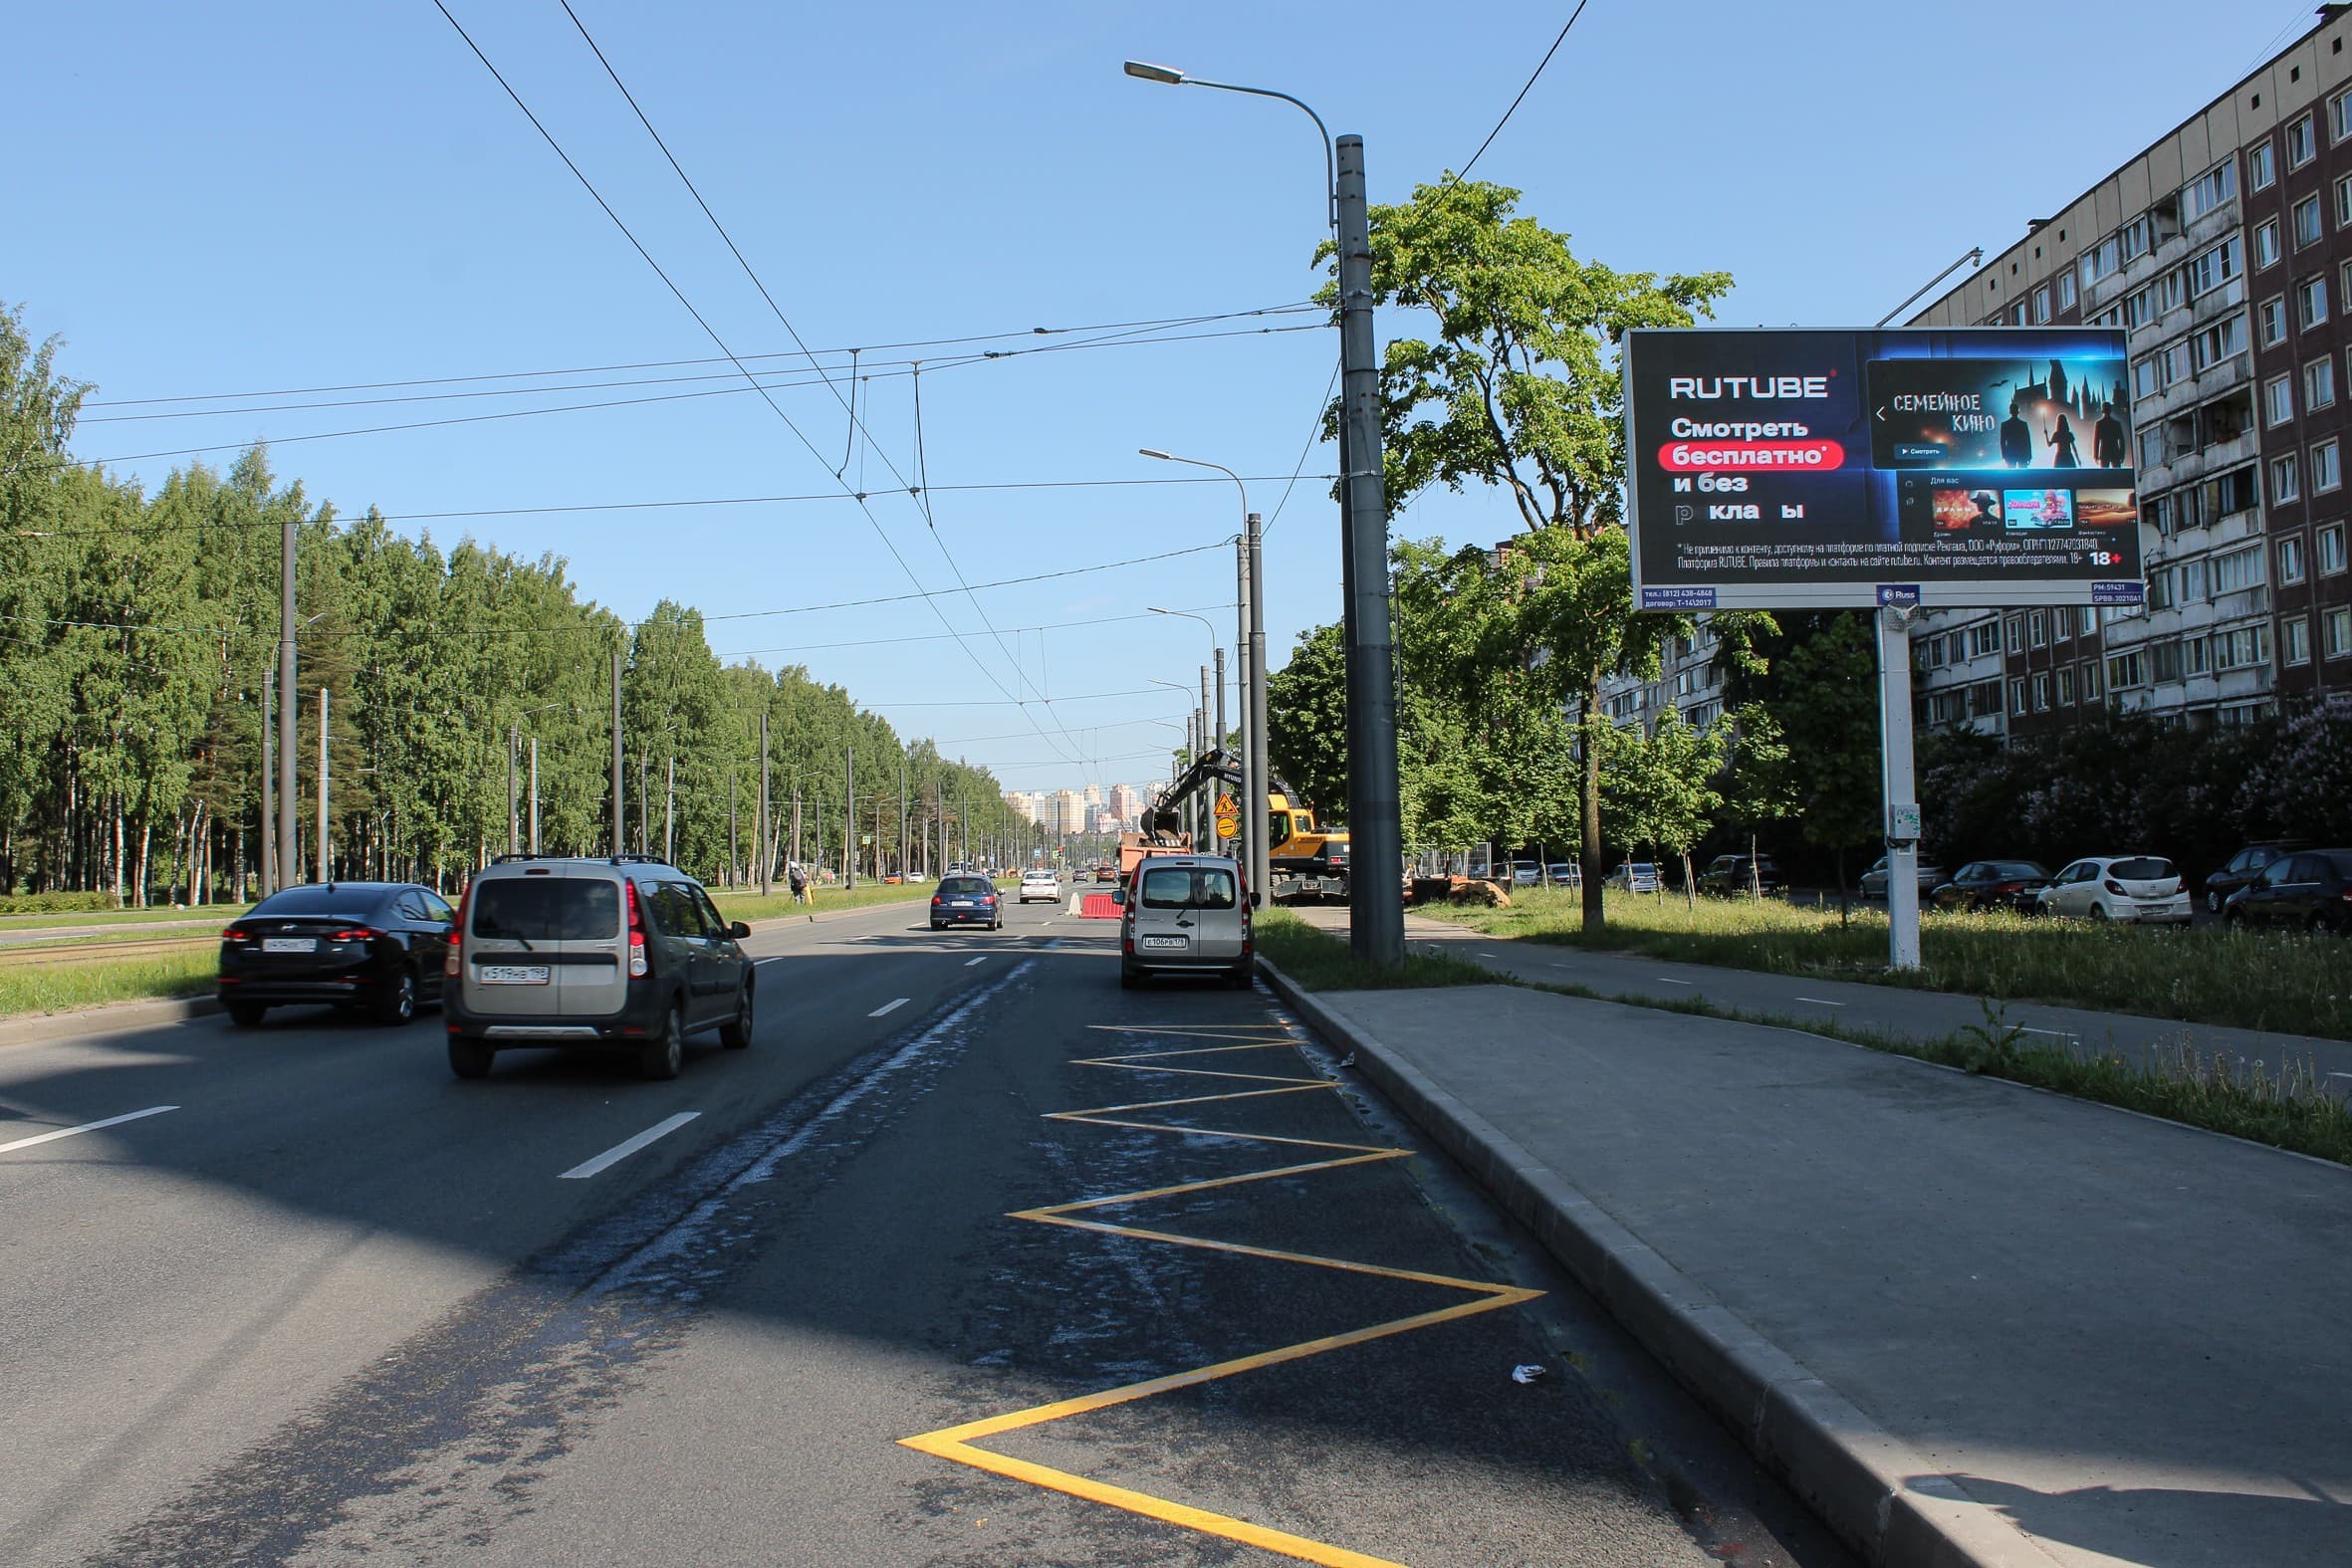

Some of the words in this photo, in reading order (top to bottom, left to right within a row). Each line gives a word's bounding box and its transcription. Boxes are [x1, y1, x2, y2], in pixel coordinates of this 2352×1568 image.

[1670, 376, 1828, 399] RUTUBE
[1893, 391, 1981, 413] СЕМЕЙНОЕ
[1671, 417, 1808, 441] Смотреть
[1952, 414, 1995, 433] КИНО
[1673, 477, 1691, 492] и
[1697, 472, 1749, 492] без
[1815, 545, 1824, 554] на
[1825, 542, 1863, 556] платформе
[1864, 544, 1873, 554] по
[1875, 542, 1903, 554] платной
[1968, 539, 1985, 552] ООО
[1678, 556, 1717, 570] Платформа
[1749, 556, 1779, 570] Правила
[1780, 556, 1819, 569] платформы
[1827, 558, 1858, 566] контакты
[1860, 558, 1869, 566] на
[1870, 555, 1890, 566] сайте
[1923, 555, 1951, 565] Контент
[1953, 556, 1998, 567] размещается
[2089, 552, 2122, 565] 18+
